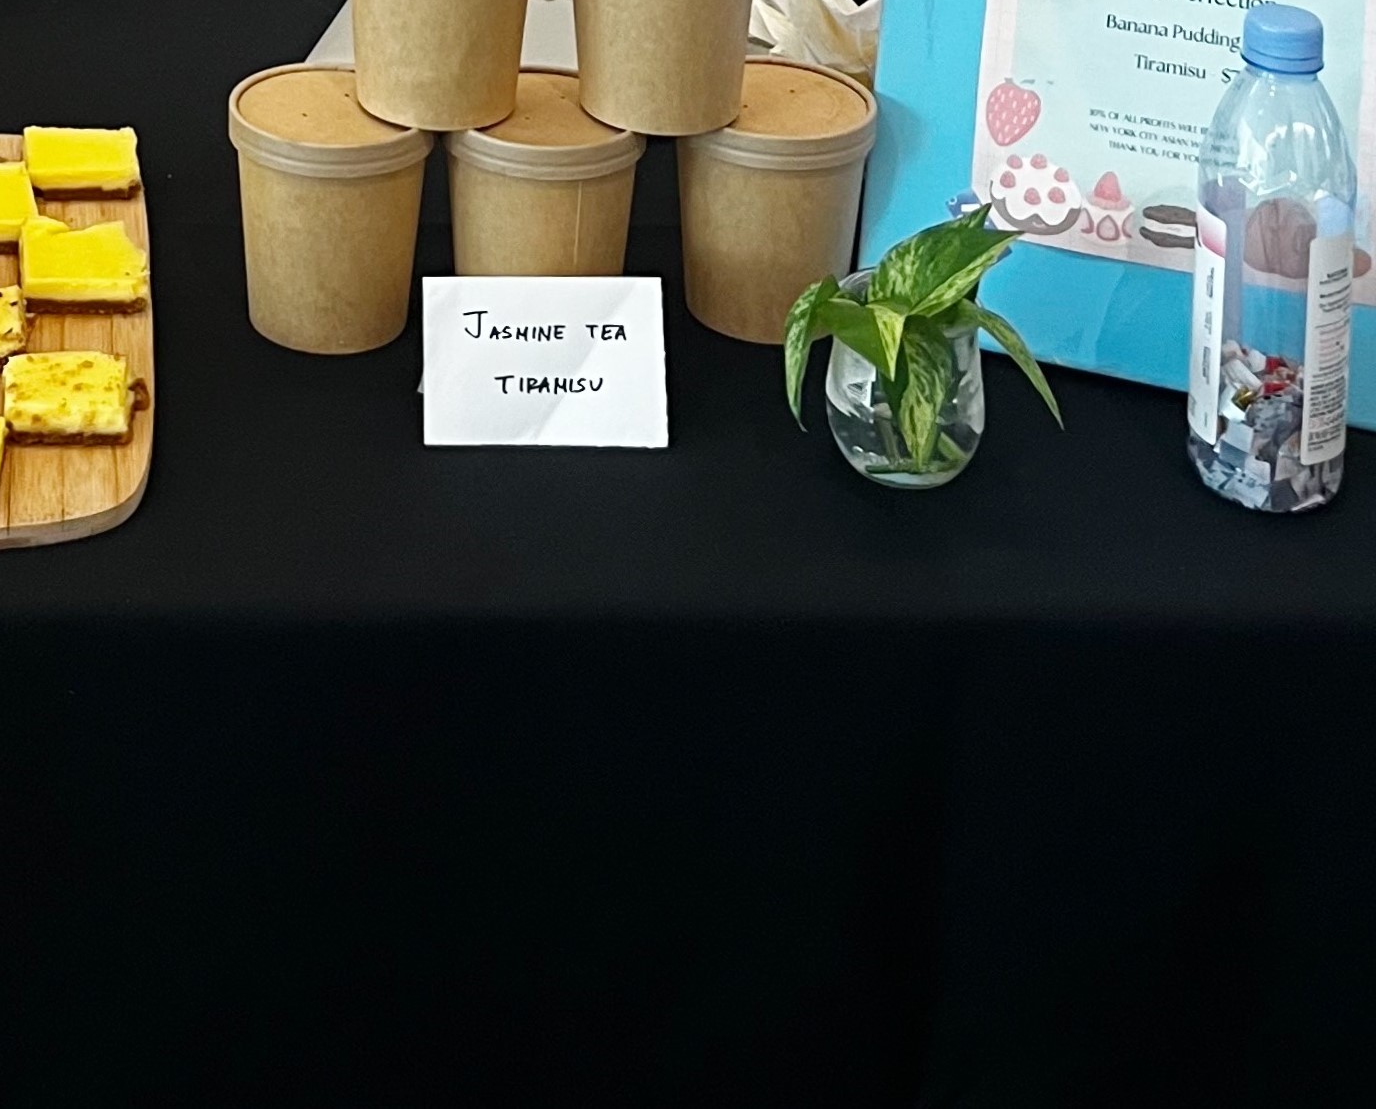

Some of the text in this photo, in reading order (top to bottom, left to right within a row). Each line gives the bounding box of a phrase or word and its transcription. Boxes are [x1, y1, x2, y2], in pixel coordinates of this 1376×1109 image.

[1106, 14, 1241, 52] Banana Pudding
[1135, 54, 1206, 79] Tiramisu
[1139, 130, 1158, 141] CITY
[1162, 148, 1180, 160] FOR
[463, 310, 628, 342] JASMINE TEA
[494, 375, 604, 394] TIRAMISU
